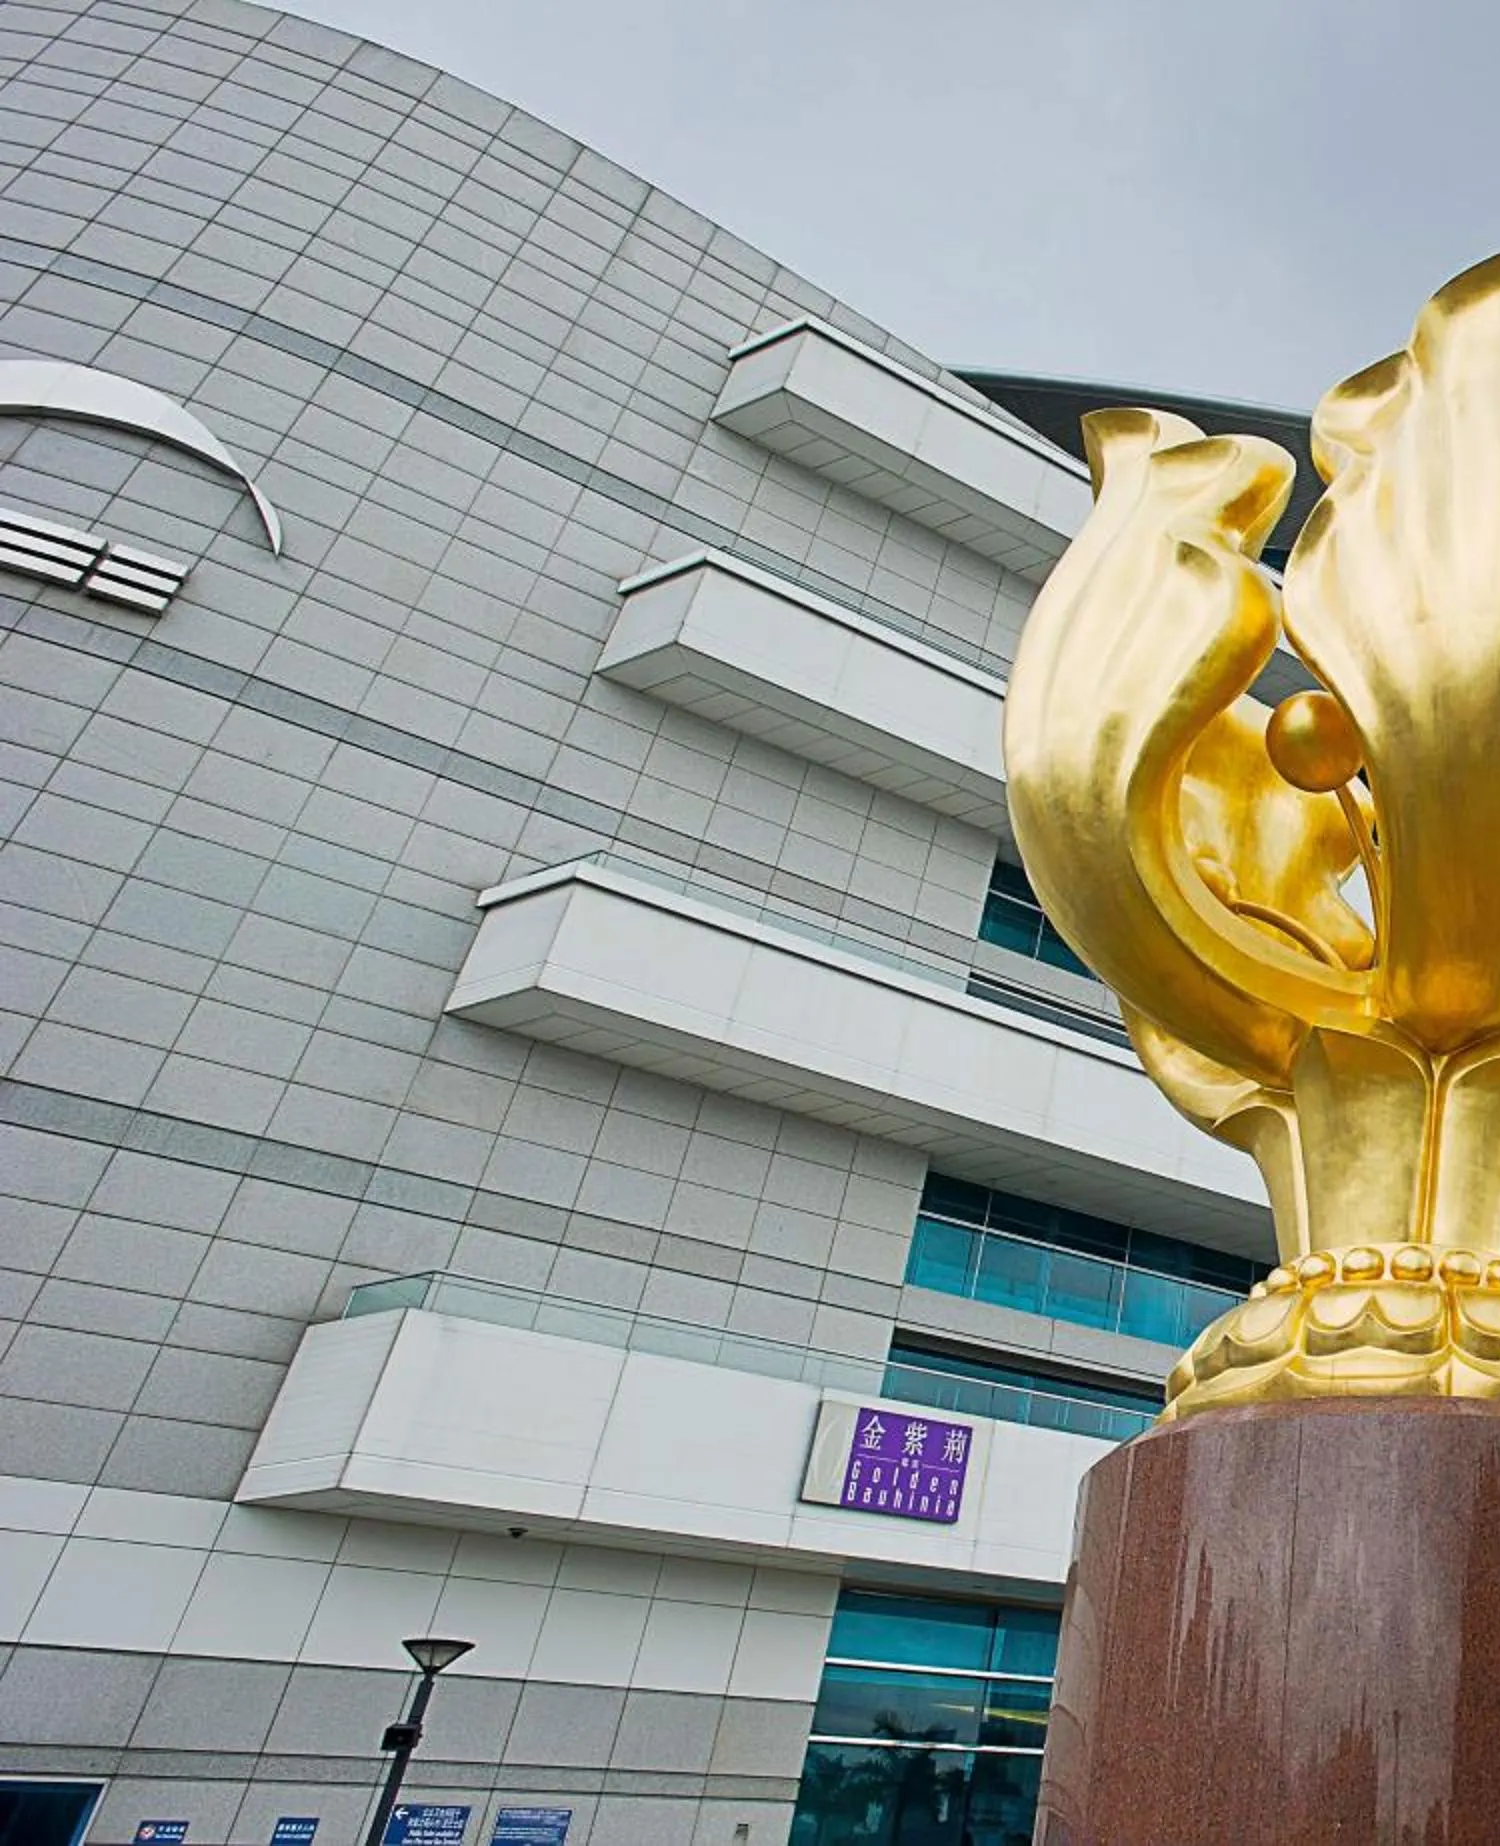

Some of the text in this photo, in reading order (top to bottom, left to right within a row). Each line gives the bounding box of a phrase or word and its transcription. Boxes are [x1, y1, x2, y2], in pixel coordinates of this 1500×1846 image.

[859, 1415, 967, 1464] 金紫荊
[851, 1460, 959, 1496] Golden
[847, 1481, 956, 1516] Bauhinia
